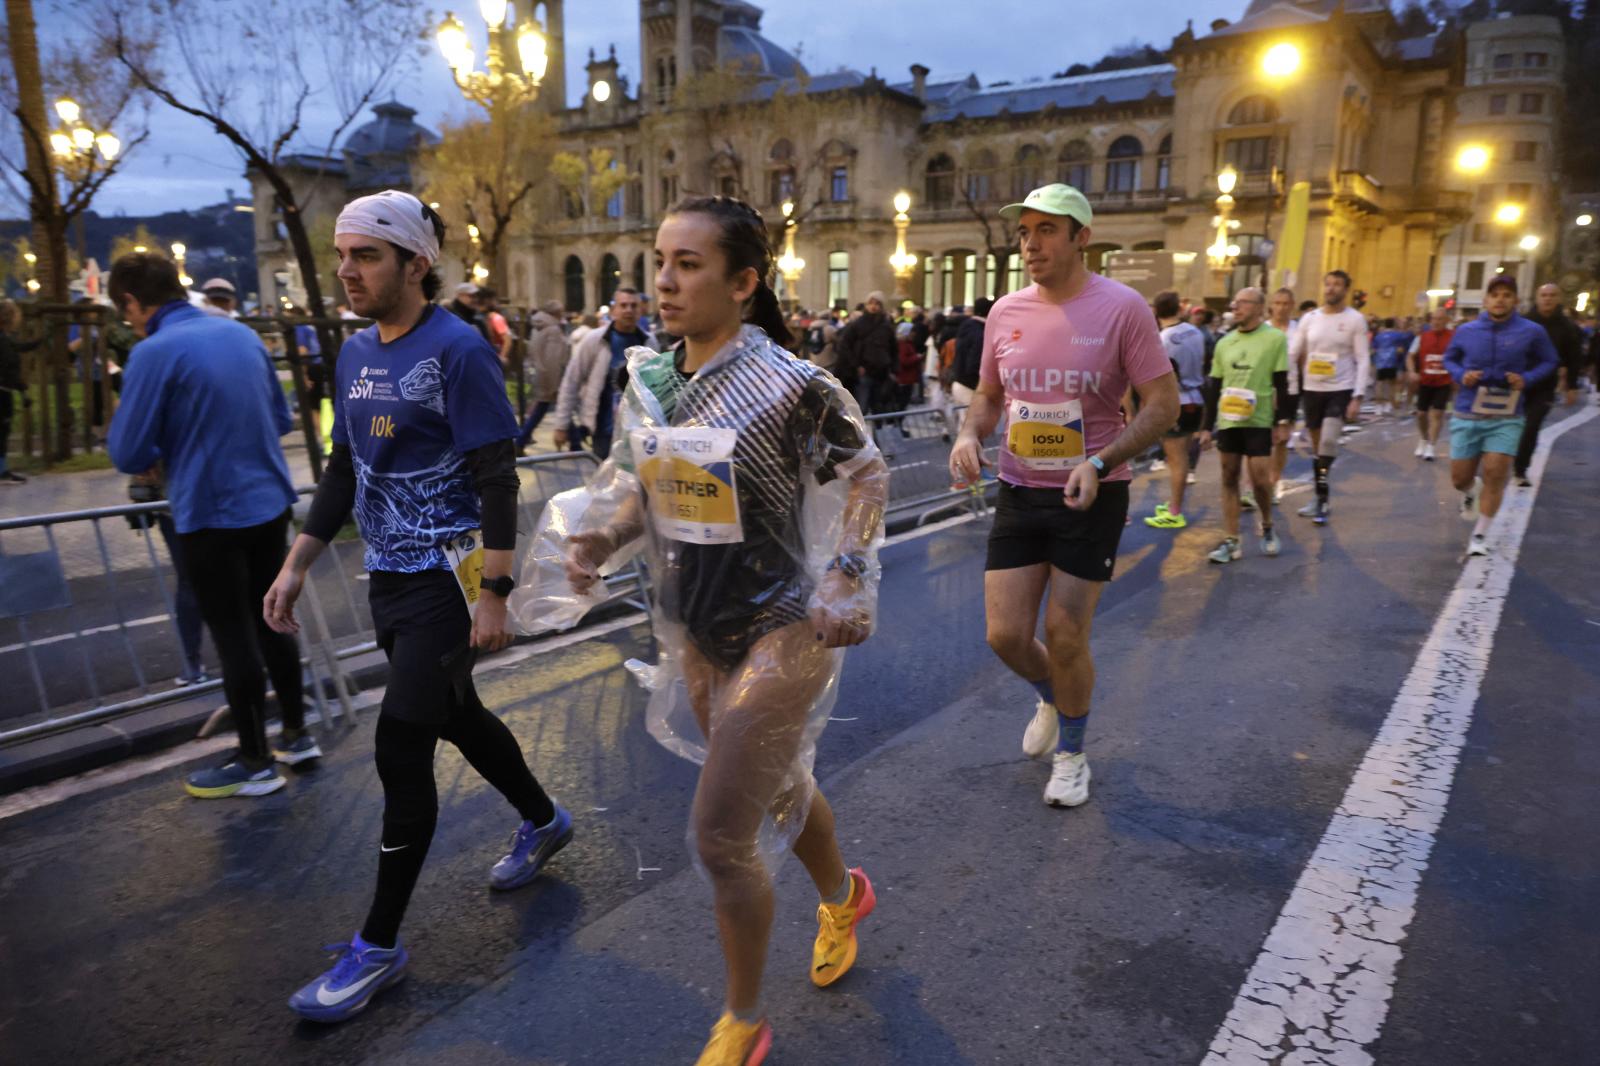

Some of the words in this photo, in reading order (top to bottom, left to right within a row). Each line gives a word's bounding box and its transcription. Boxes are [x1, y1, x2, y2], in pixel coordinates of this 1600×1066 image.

[1032, 410, 1070, 420] ZURICH
[370, 414, 396, 438] 10k
[664, 439, 712, 453] URICH
[1032, 434, 1065, 444] IOSU
[656, 479, 720, 498] ESTHER
